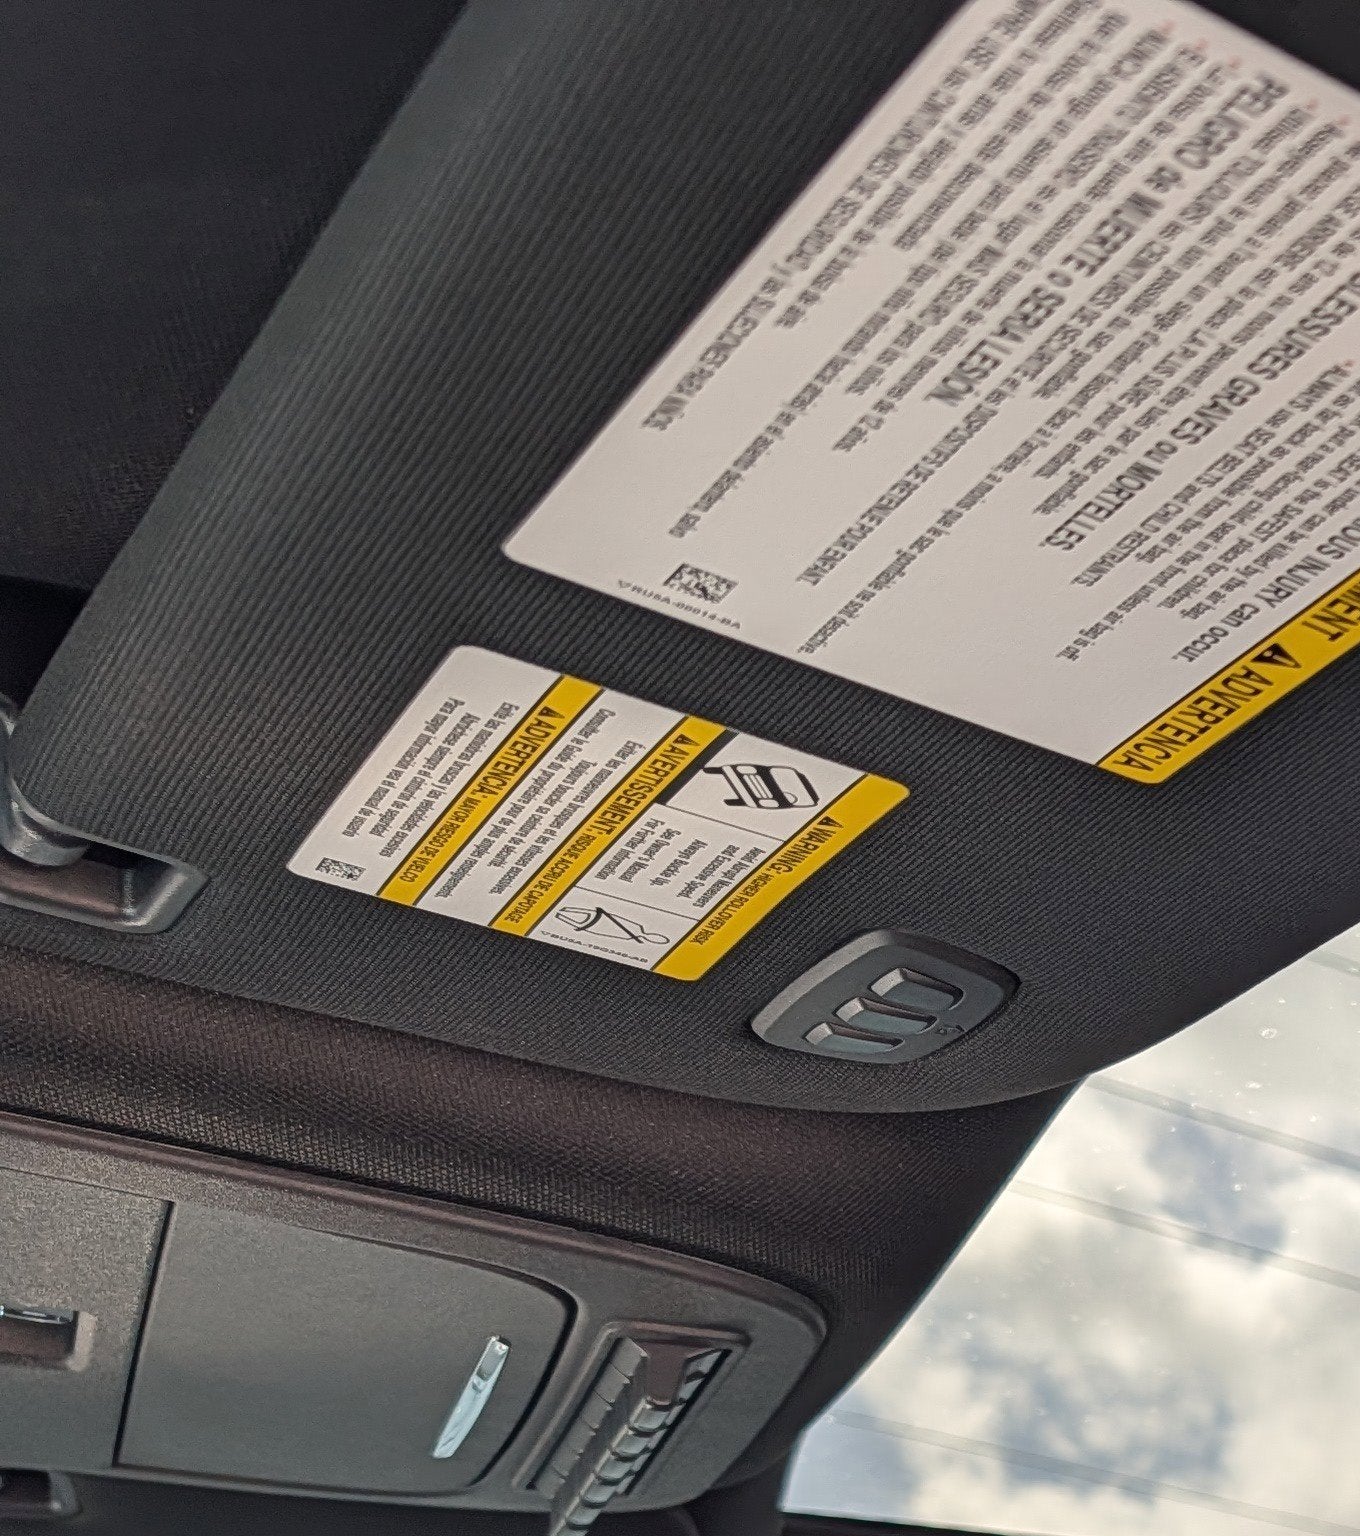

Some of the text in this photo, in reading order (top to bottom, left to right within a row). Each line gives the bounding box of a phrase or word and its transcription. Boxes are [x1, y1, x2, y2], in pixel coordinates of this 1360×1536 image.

[1171, 72, 1291, 170] PELIGRO
[1142, 163, 1183, 194] de
[1059, 190, 1164, 278] MUERTE
[1045, 269, 1074, 288] o
[922, 337, 1012, 407] LESIÓN.
[1168, 375, 1261, 445] GRAVES
[1313, 406, 1343, 425] far
[1280, 420, 1325, 448] back
[1325, 424, 1357, 448] put
[1141, 439, 1179, 464] ou
[1069, 363, 1350, 587] ALWAYS use SEAT BELTS and CHILD RESTRAINTS.
[1219, 455, 1276, 499] possible
[1251, 450, 1326, 502] rear-facing
[1037, 460, 1162, 551] MORTELLES.
[1192, 494, 1232, 520] from
[1291, 487, 1323, 506] the
[1320, 486, 1360, 517] under
[1174, 516, 1206, 535] the
[1227, 498, 1264, 527] child
[1247, 502, 1304, 544] SAFEST
[1297, 512, 1327, 533] can
[1203, 520, 1237, 544] seat
[1133, 542, 1173, 564] bag.
[1173, 548, 1204, 567] the
[1216, 535, 1255, 564] place
[1251, 541, 1293, 570] killed
[1147, 563, 1187, 589] front
[1201, 560, 1230, 578] for
[1233, 563, 1264, 580] by
[1253, 554, 1331, 609] INJURY
[1114, 583, 1157, 614] unless
[1155, 573, 1209, 609] children.
[1218, 575, 1248, 593] the
[1178, 600, 1216, 620] bag.
[1219, 601, 1261, 628] can
[1077, 620, 1115, 640] bag
[1170, 624, 1230, 663] occur.
[1111, 664, 1274, 772] ADVERTENCIA
[397, 716, 557, 883] ADVERTENCIA: MAYOR RIESGO DE VUELCO
[502, 742, 690, 924] AVERTISSEMENT: RISQUE ACCRU DE CAPOTAGE
[676, 837, 709, 860] Always
[658, 857, 690, 878] Buckle
[693, 853, 732, 882] Excessive
[674, 879, 706, 899] Speed.
[687, 825, 837, 946] WARNING: HIGHER ROLLOVER RISK
